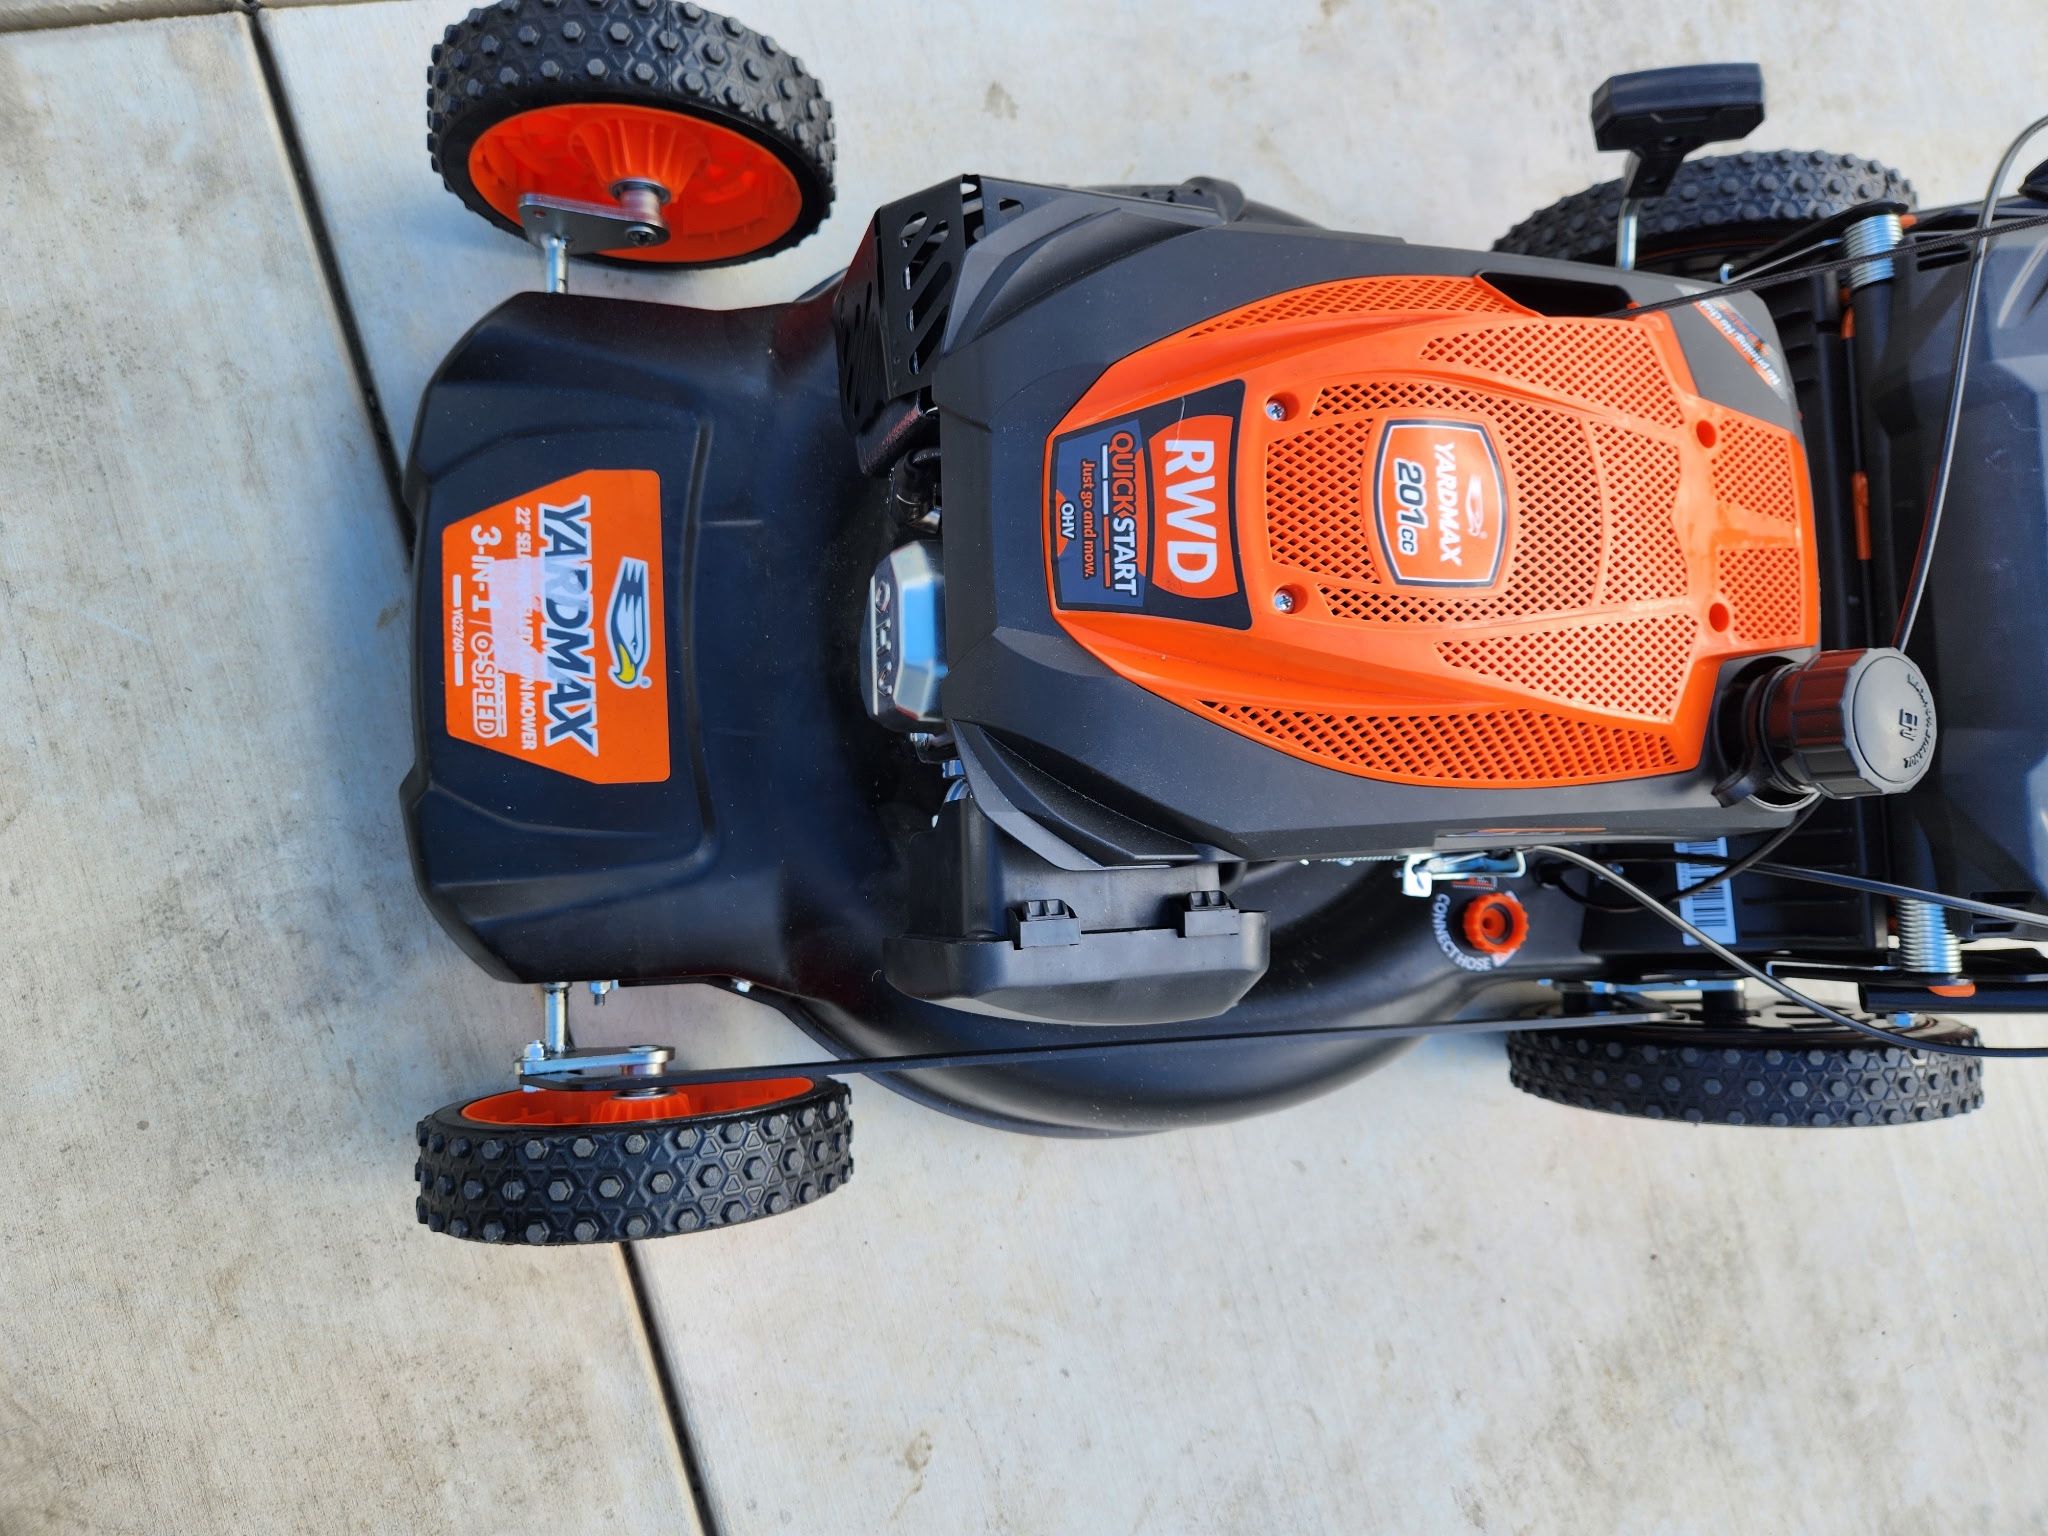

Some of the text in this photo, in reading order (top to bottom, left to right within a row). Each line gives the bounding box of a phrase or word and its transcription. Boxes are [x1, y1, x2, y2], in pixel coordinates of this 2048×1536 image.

[515, 506, 531, 530] 22"
[1061, 503, 1075, 539] OHV
[1080, 460, 1097, 577] Just go and mow.
[1165, 439, 1218, 583] RWD
[1434, 443, 1463, 567] YARDMAX
[470, 524, 503, 612] 3-IN-1
[452, 607, 465, 653] YG2760
[538, 495, 600, 757] YARDMAX
[875, 580, 893, 697] OHV
[519, 690, 538, 751] MOWER
[1432, 893, 1493, 972] CONNECT HOSE
